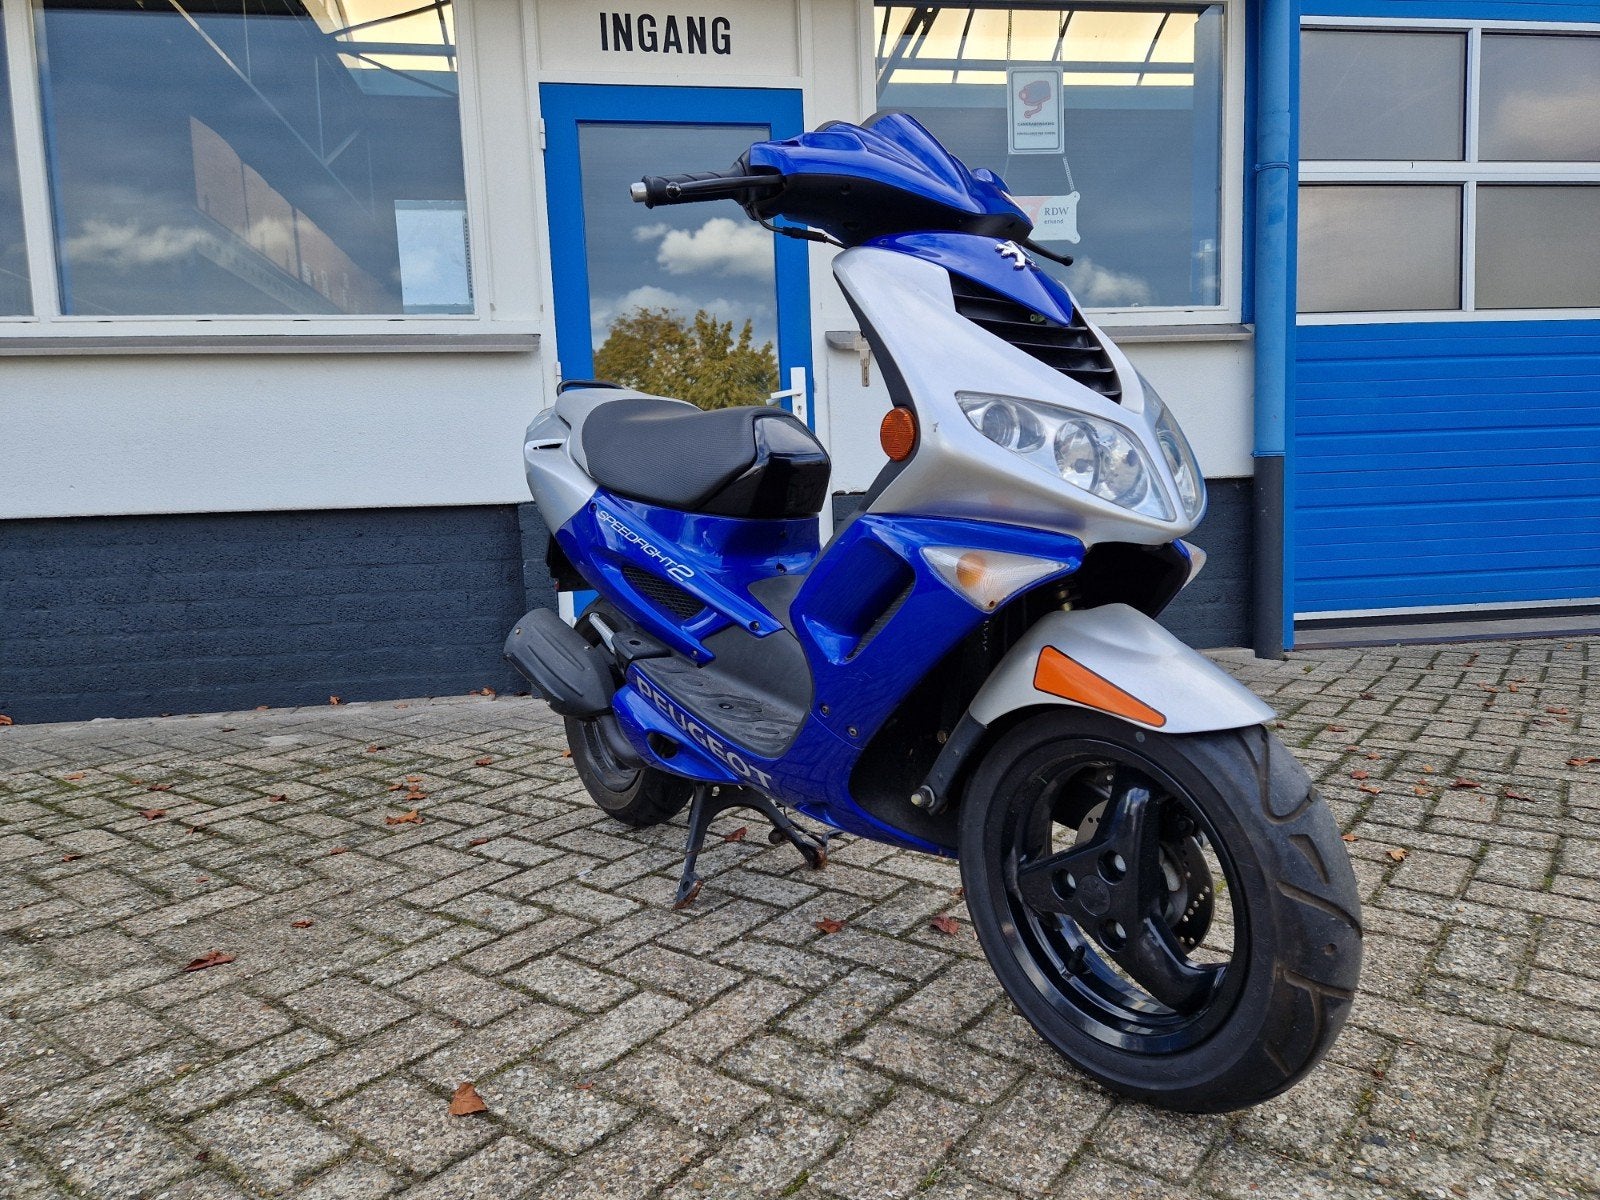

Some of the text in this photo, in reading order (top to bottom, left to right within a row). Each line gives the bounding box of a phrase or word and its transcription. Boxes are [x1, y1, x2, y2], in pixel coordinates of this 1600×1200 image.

[600, 12, 731, 54] INGANG
[1044, 207, 1070, 216] RDW
[636, 675, 772, 789] PEUGEOT
